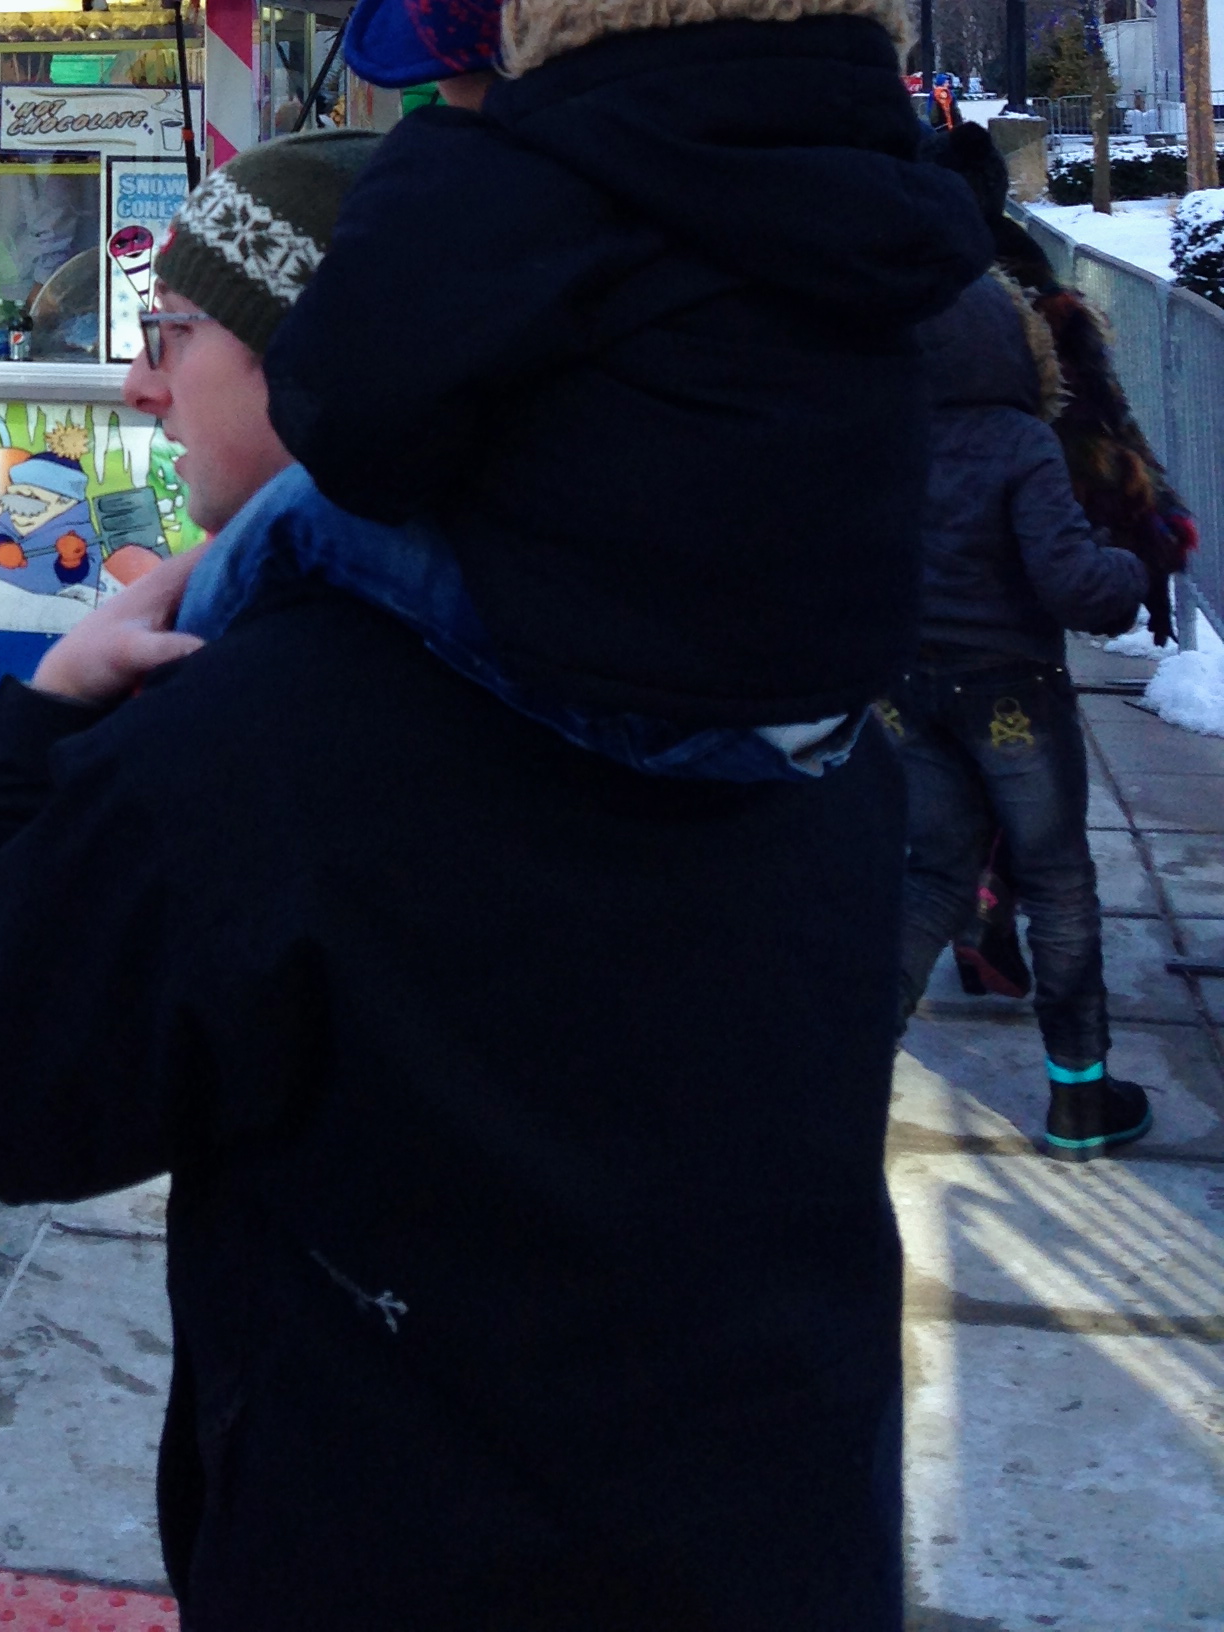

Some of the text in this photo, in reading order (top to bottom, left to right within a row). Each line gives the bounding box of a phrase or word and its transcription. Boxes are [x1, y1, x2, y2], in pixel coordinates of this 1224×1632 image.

[14, 99, 67, 118] HOT
[6, 111, 148, 136] CHOCOLATE
[119, 173, 187, 195] SNOW
